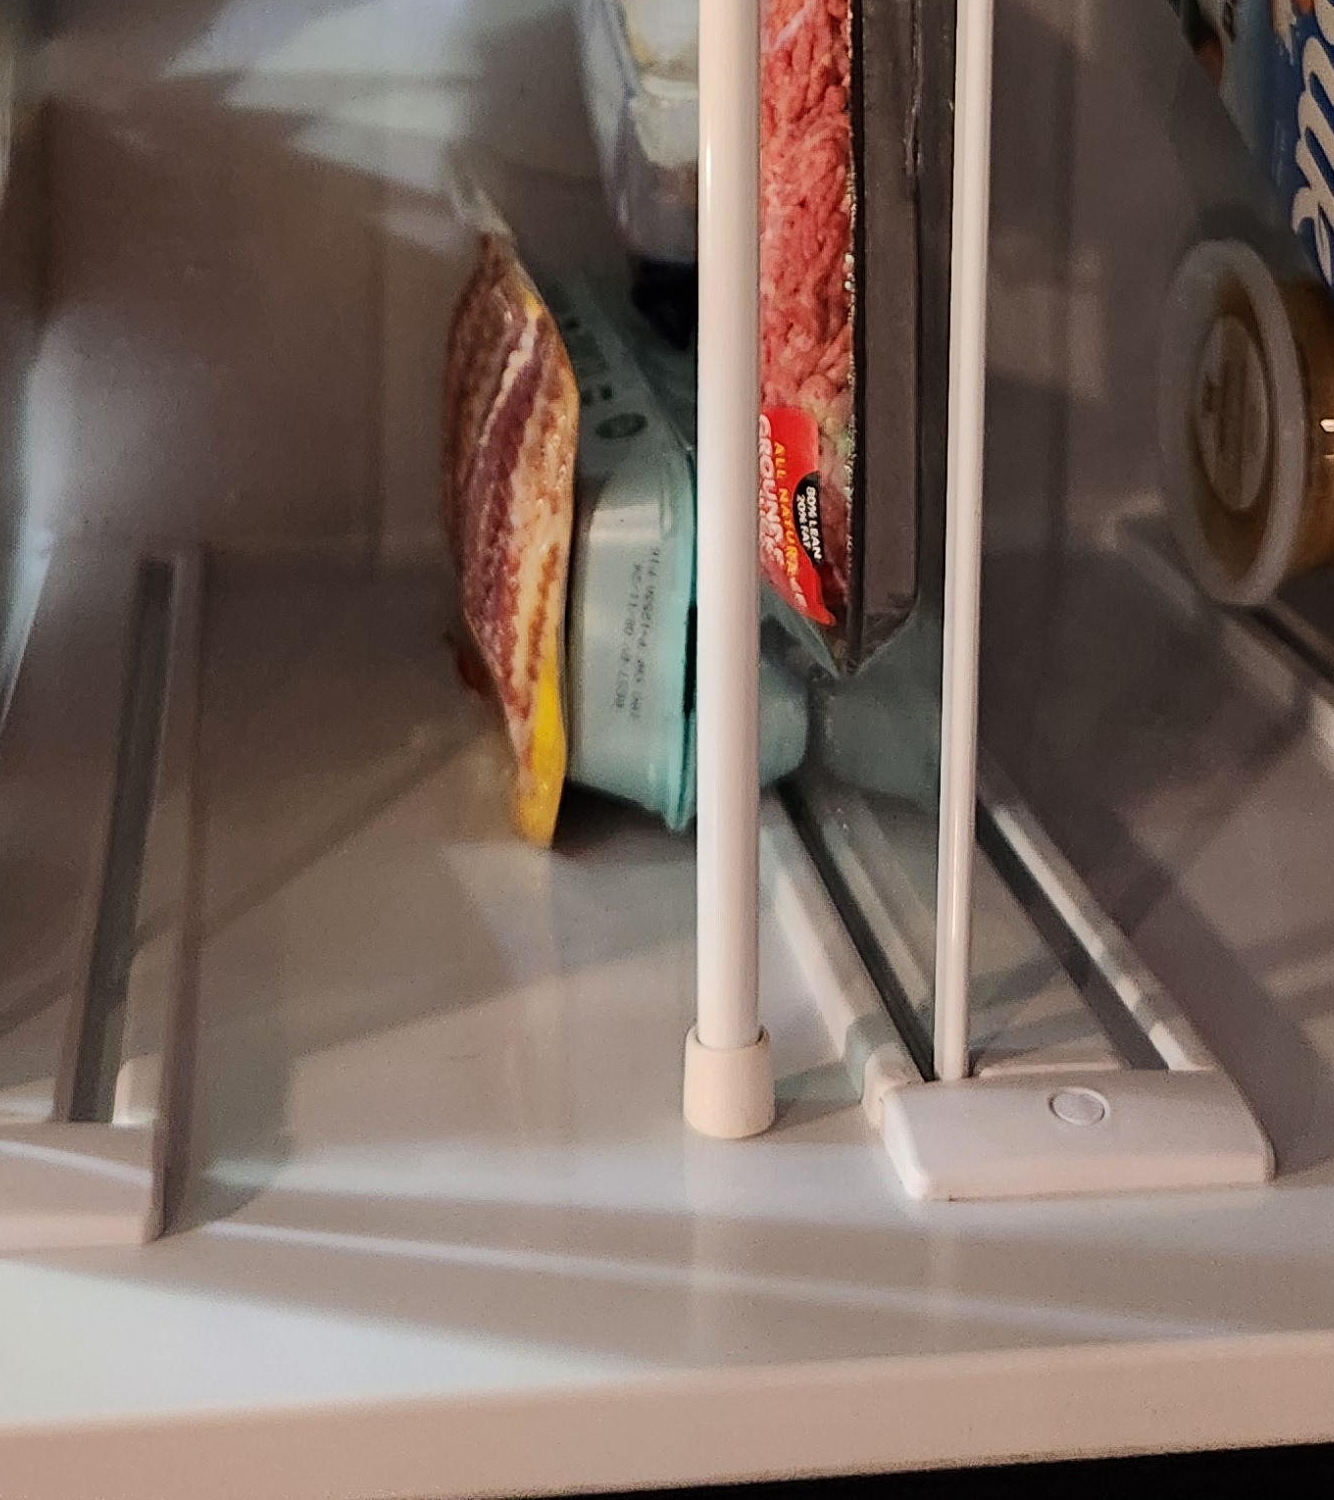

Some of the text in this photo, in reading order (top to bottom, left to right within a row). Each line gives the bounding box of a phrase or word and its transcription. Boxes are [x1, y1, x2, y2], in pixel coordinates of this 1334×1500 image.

[774, 441, 787, 479] ALL
[796, 494, 811, 550] 20% FAT
[806, 485, 823, 560] 80% LEAN
